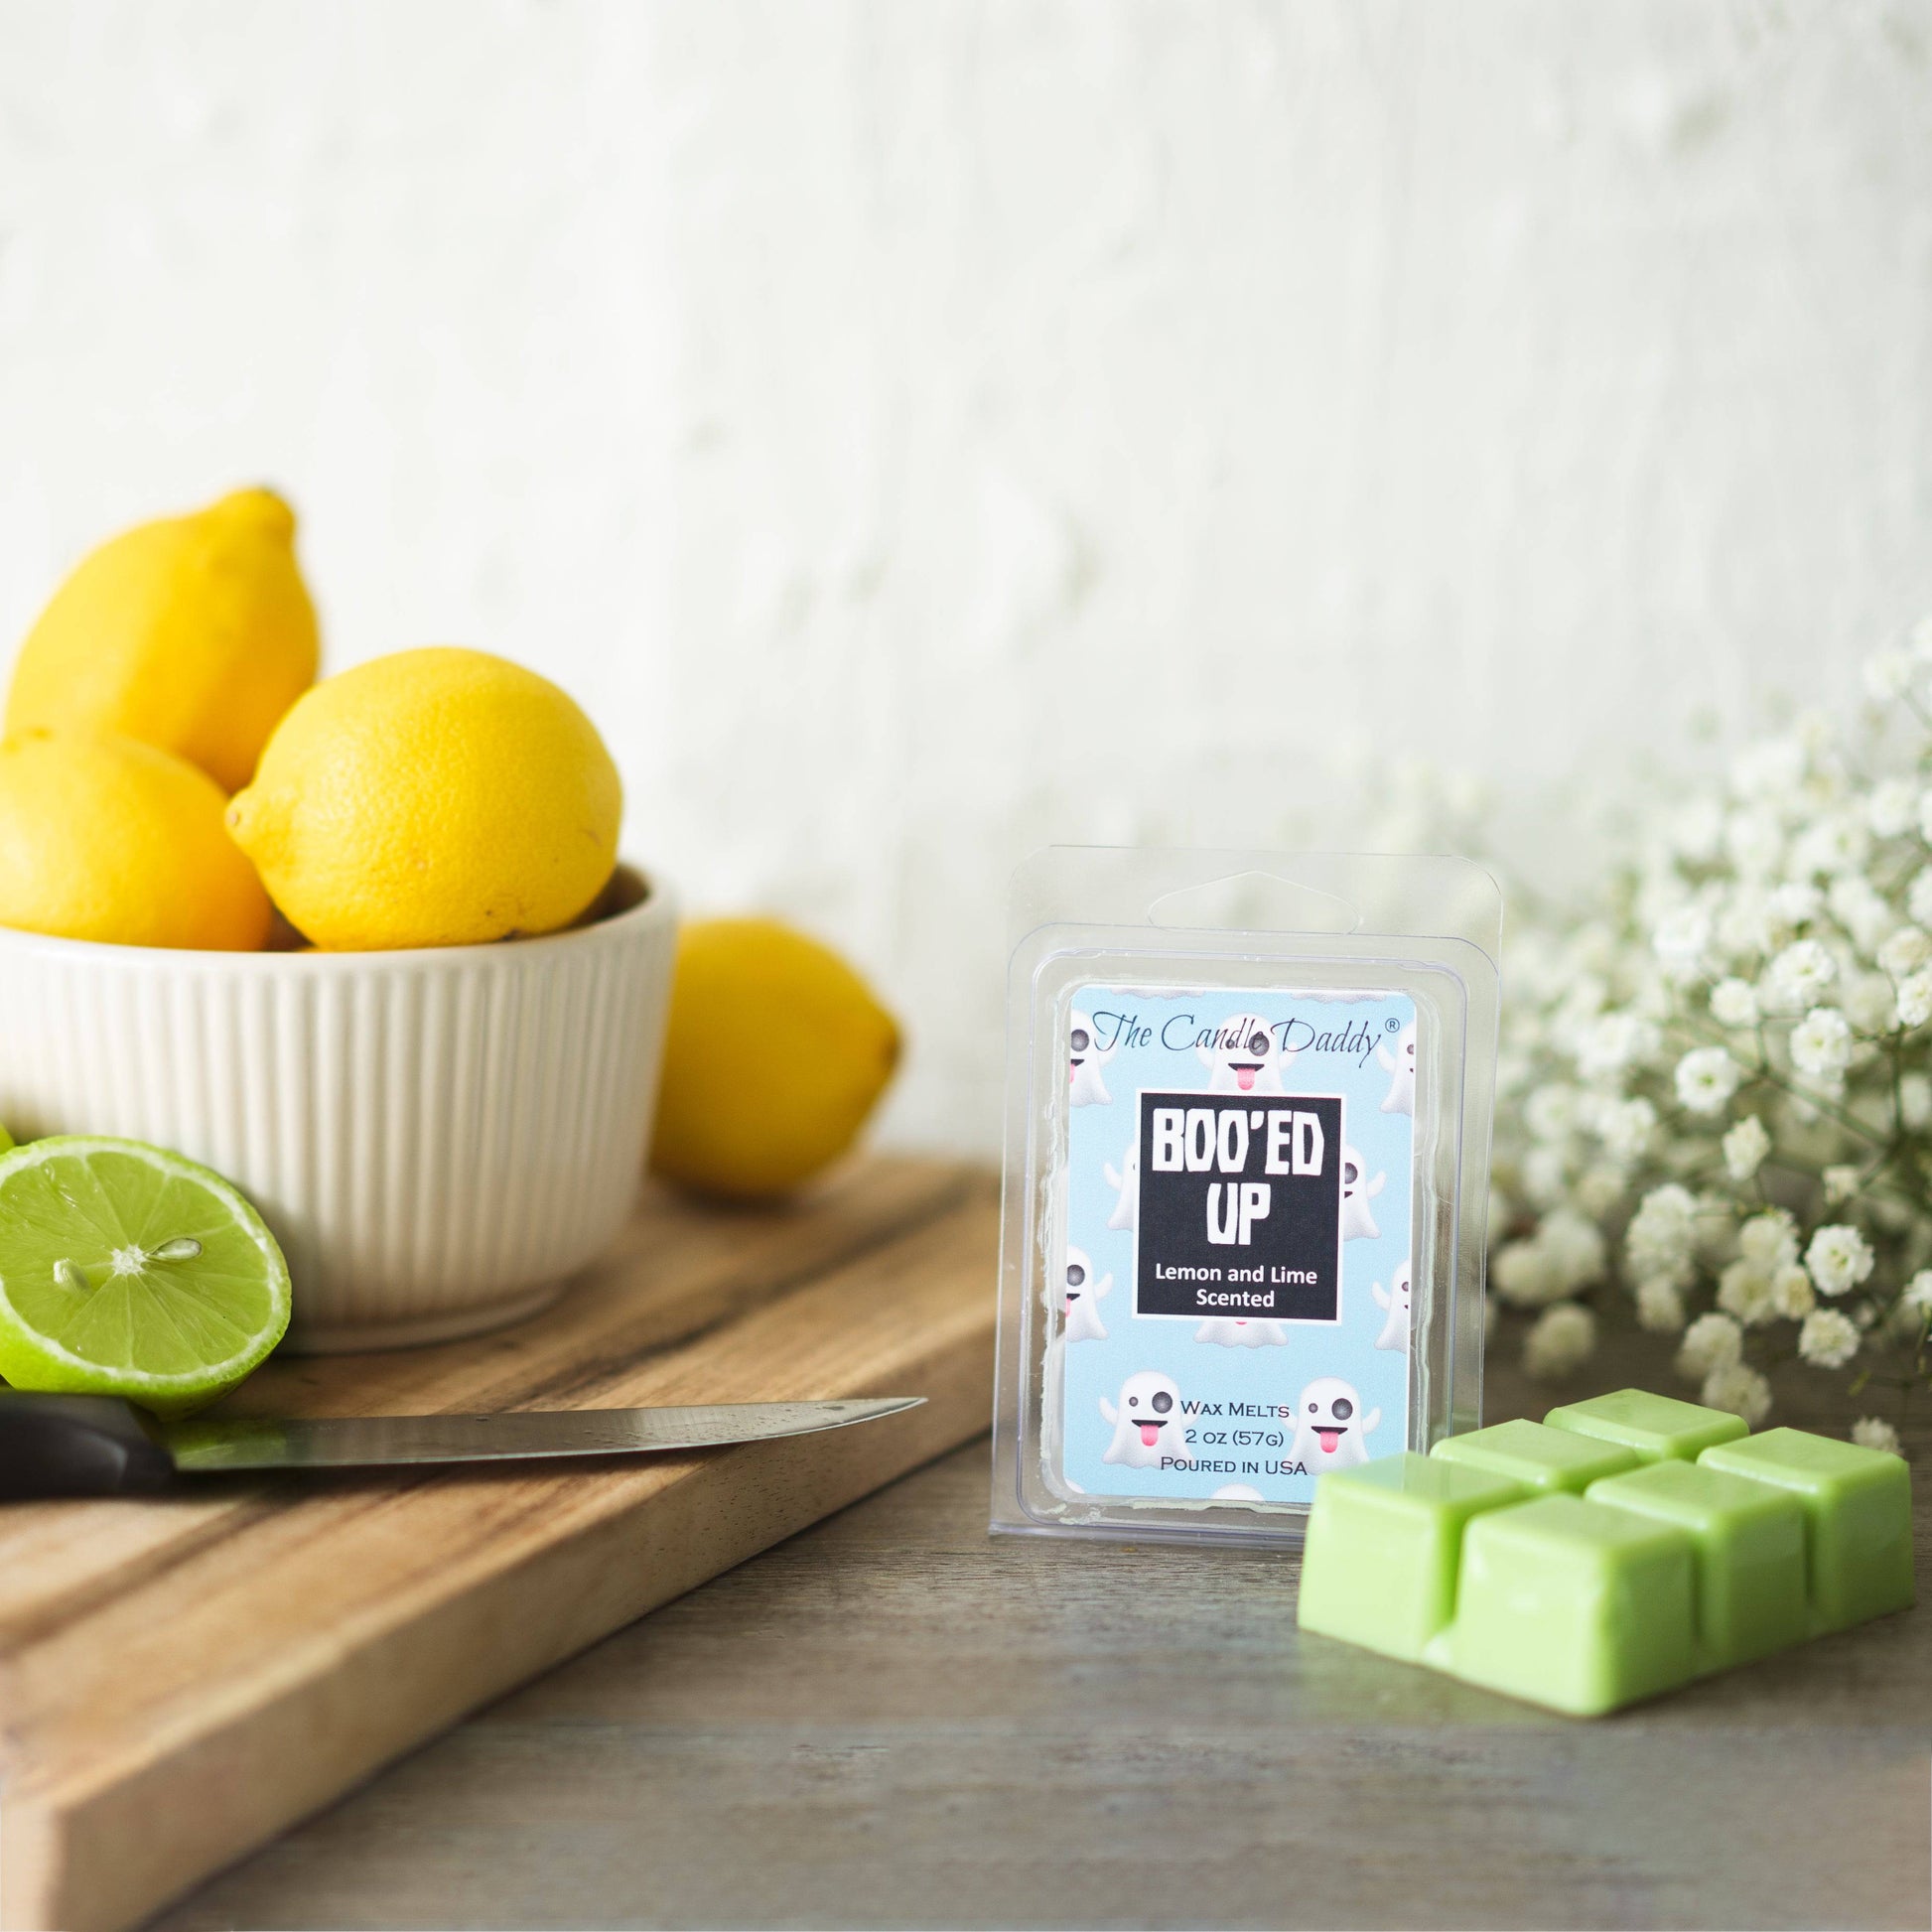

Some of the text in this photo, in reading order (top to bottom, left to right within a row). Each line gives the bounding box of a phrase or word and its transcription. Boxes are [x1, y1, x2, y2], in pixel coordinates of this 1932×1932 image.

[1092, 1011, 1153, 1052] The
[1161, 1014, 1263, 1051] Candle
[1152, 1107, 1325, 1176] BOO'ED
[1206, 1181, 1272, 1246] UP
[1156, 1262, 1318, 1285] Lemon and Lime
[1195, 1288, 1275, 1308] Scented
[1184, 1429, 1197, 1444] 2
[1265, 1460, 1309, 1476] USA
